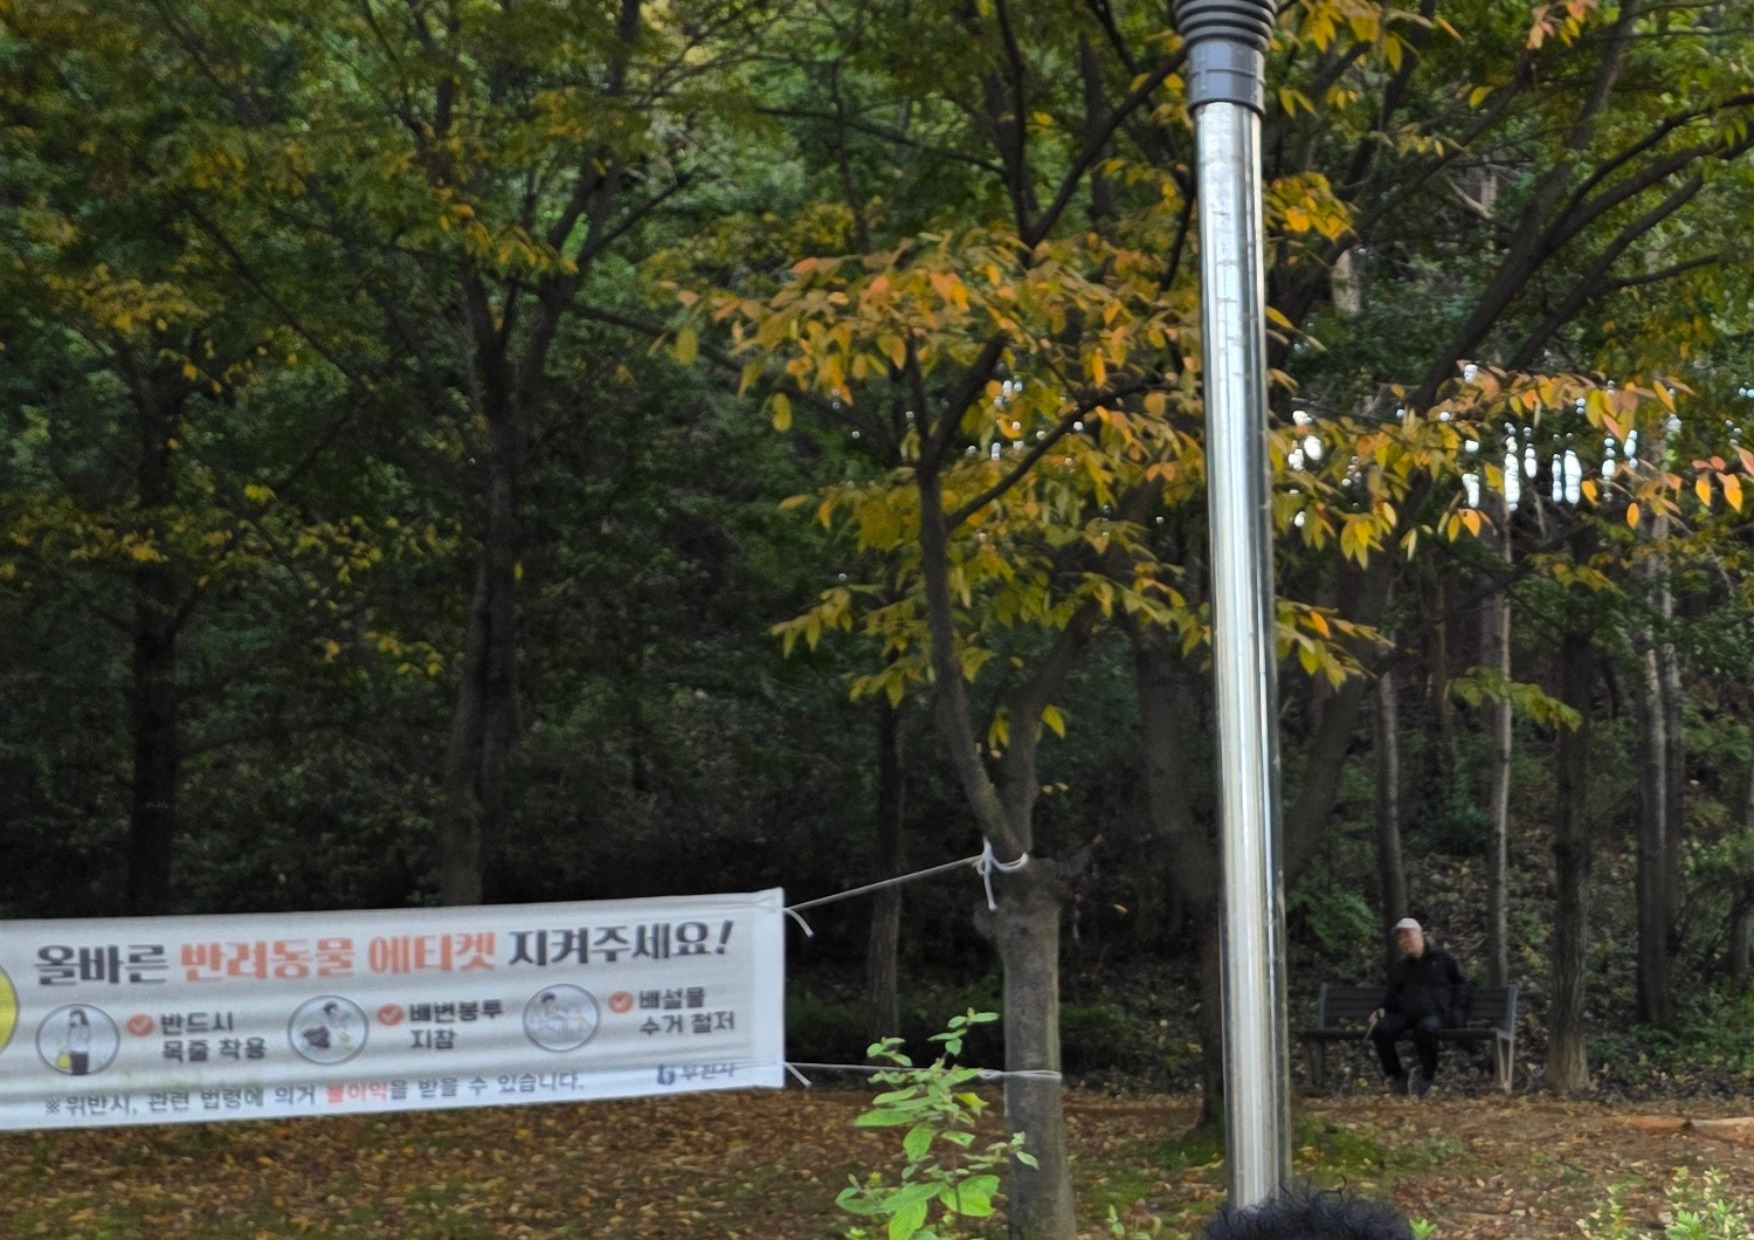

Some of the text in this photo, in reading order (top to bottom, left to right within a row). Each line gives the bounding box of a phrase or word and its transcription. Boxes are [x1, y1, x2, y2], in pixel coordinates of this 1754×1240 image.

[35, 919, 735, 986] 올바른 반려동물 에티켓 지켜주세요!
[639, 986, 704, 1010] 배설물
[409, 1000, 502, 1023] 배변봉투
[160, 1012, 234, 1036] 반드시
[639, 1015, 683, 1036] 수거
[163, 1037, 267, 1063] 목줄 착용
[410, 1028, 456, 1050] 지참
[468, 1076, 487, 1096] 수
